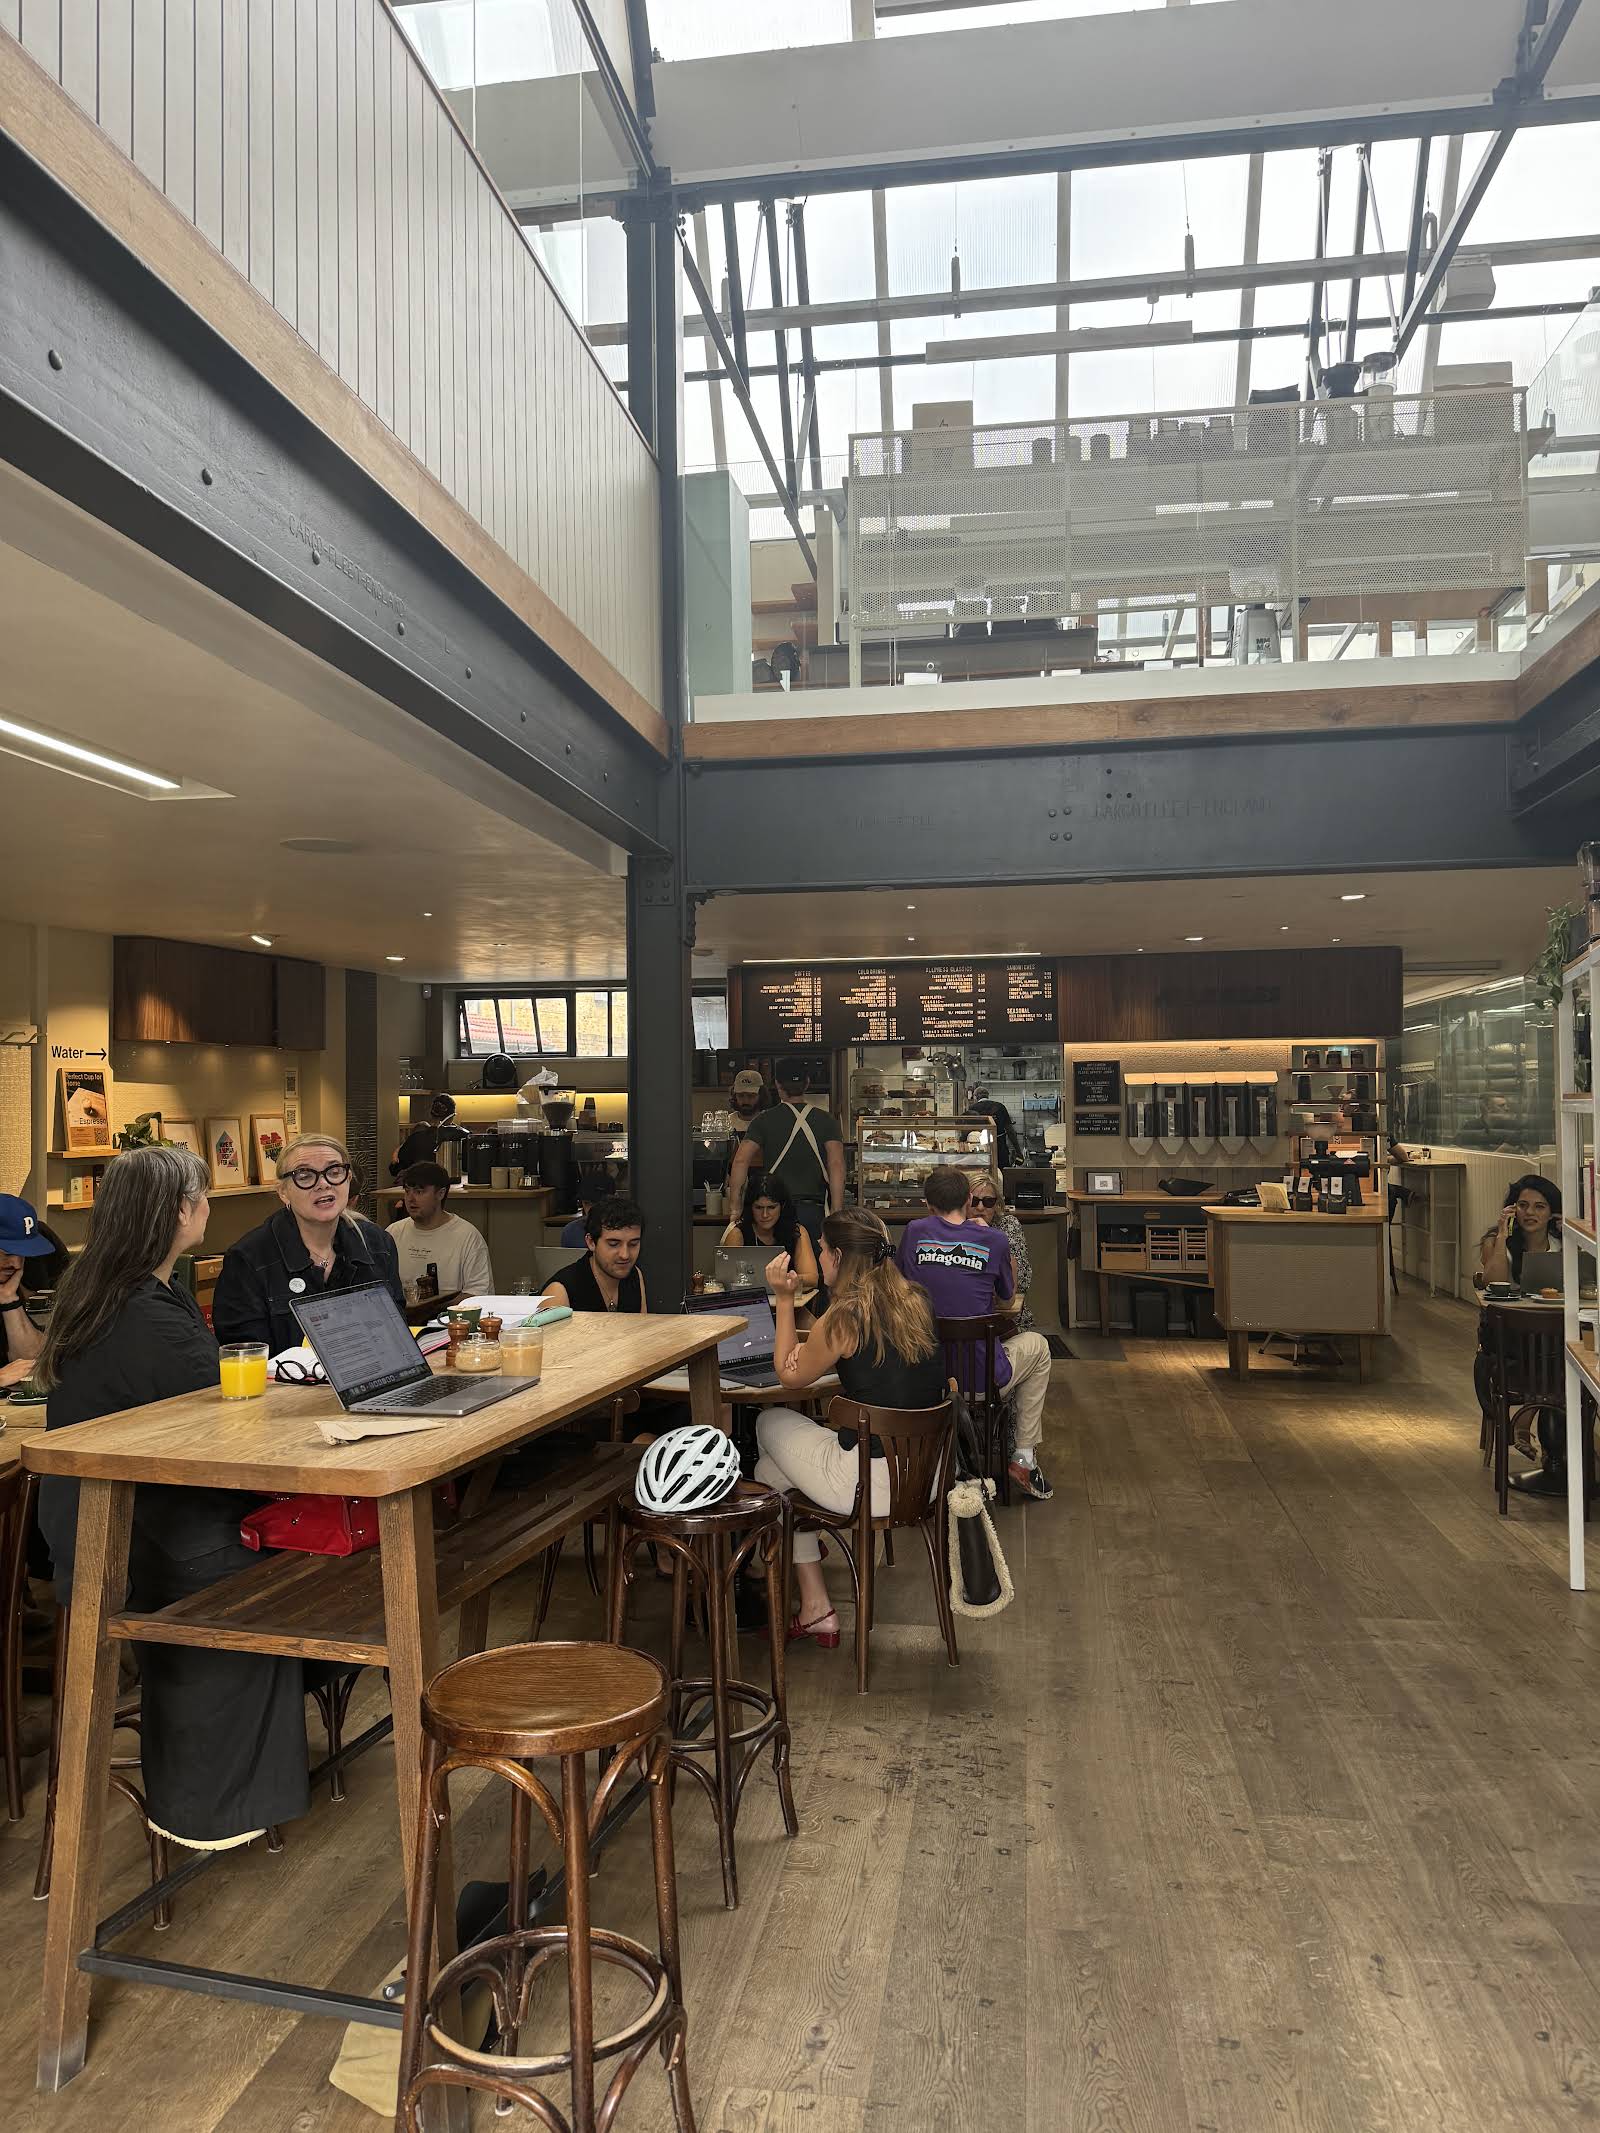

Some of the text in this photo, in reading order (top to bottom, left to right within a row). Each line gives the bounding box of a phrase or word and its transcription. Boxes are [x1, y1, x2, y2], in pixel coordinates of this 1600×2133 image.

[51, 1045, 84, 1059] Water
[84, 1073, 95, 1082] Cup
[23, 1216, 34, 1235] P
[918, 1252, 983, 1270] patagonia
